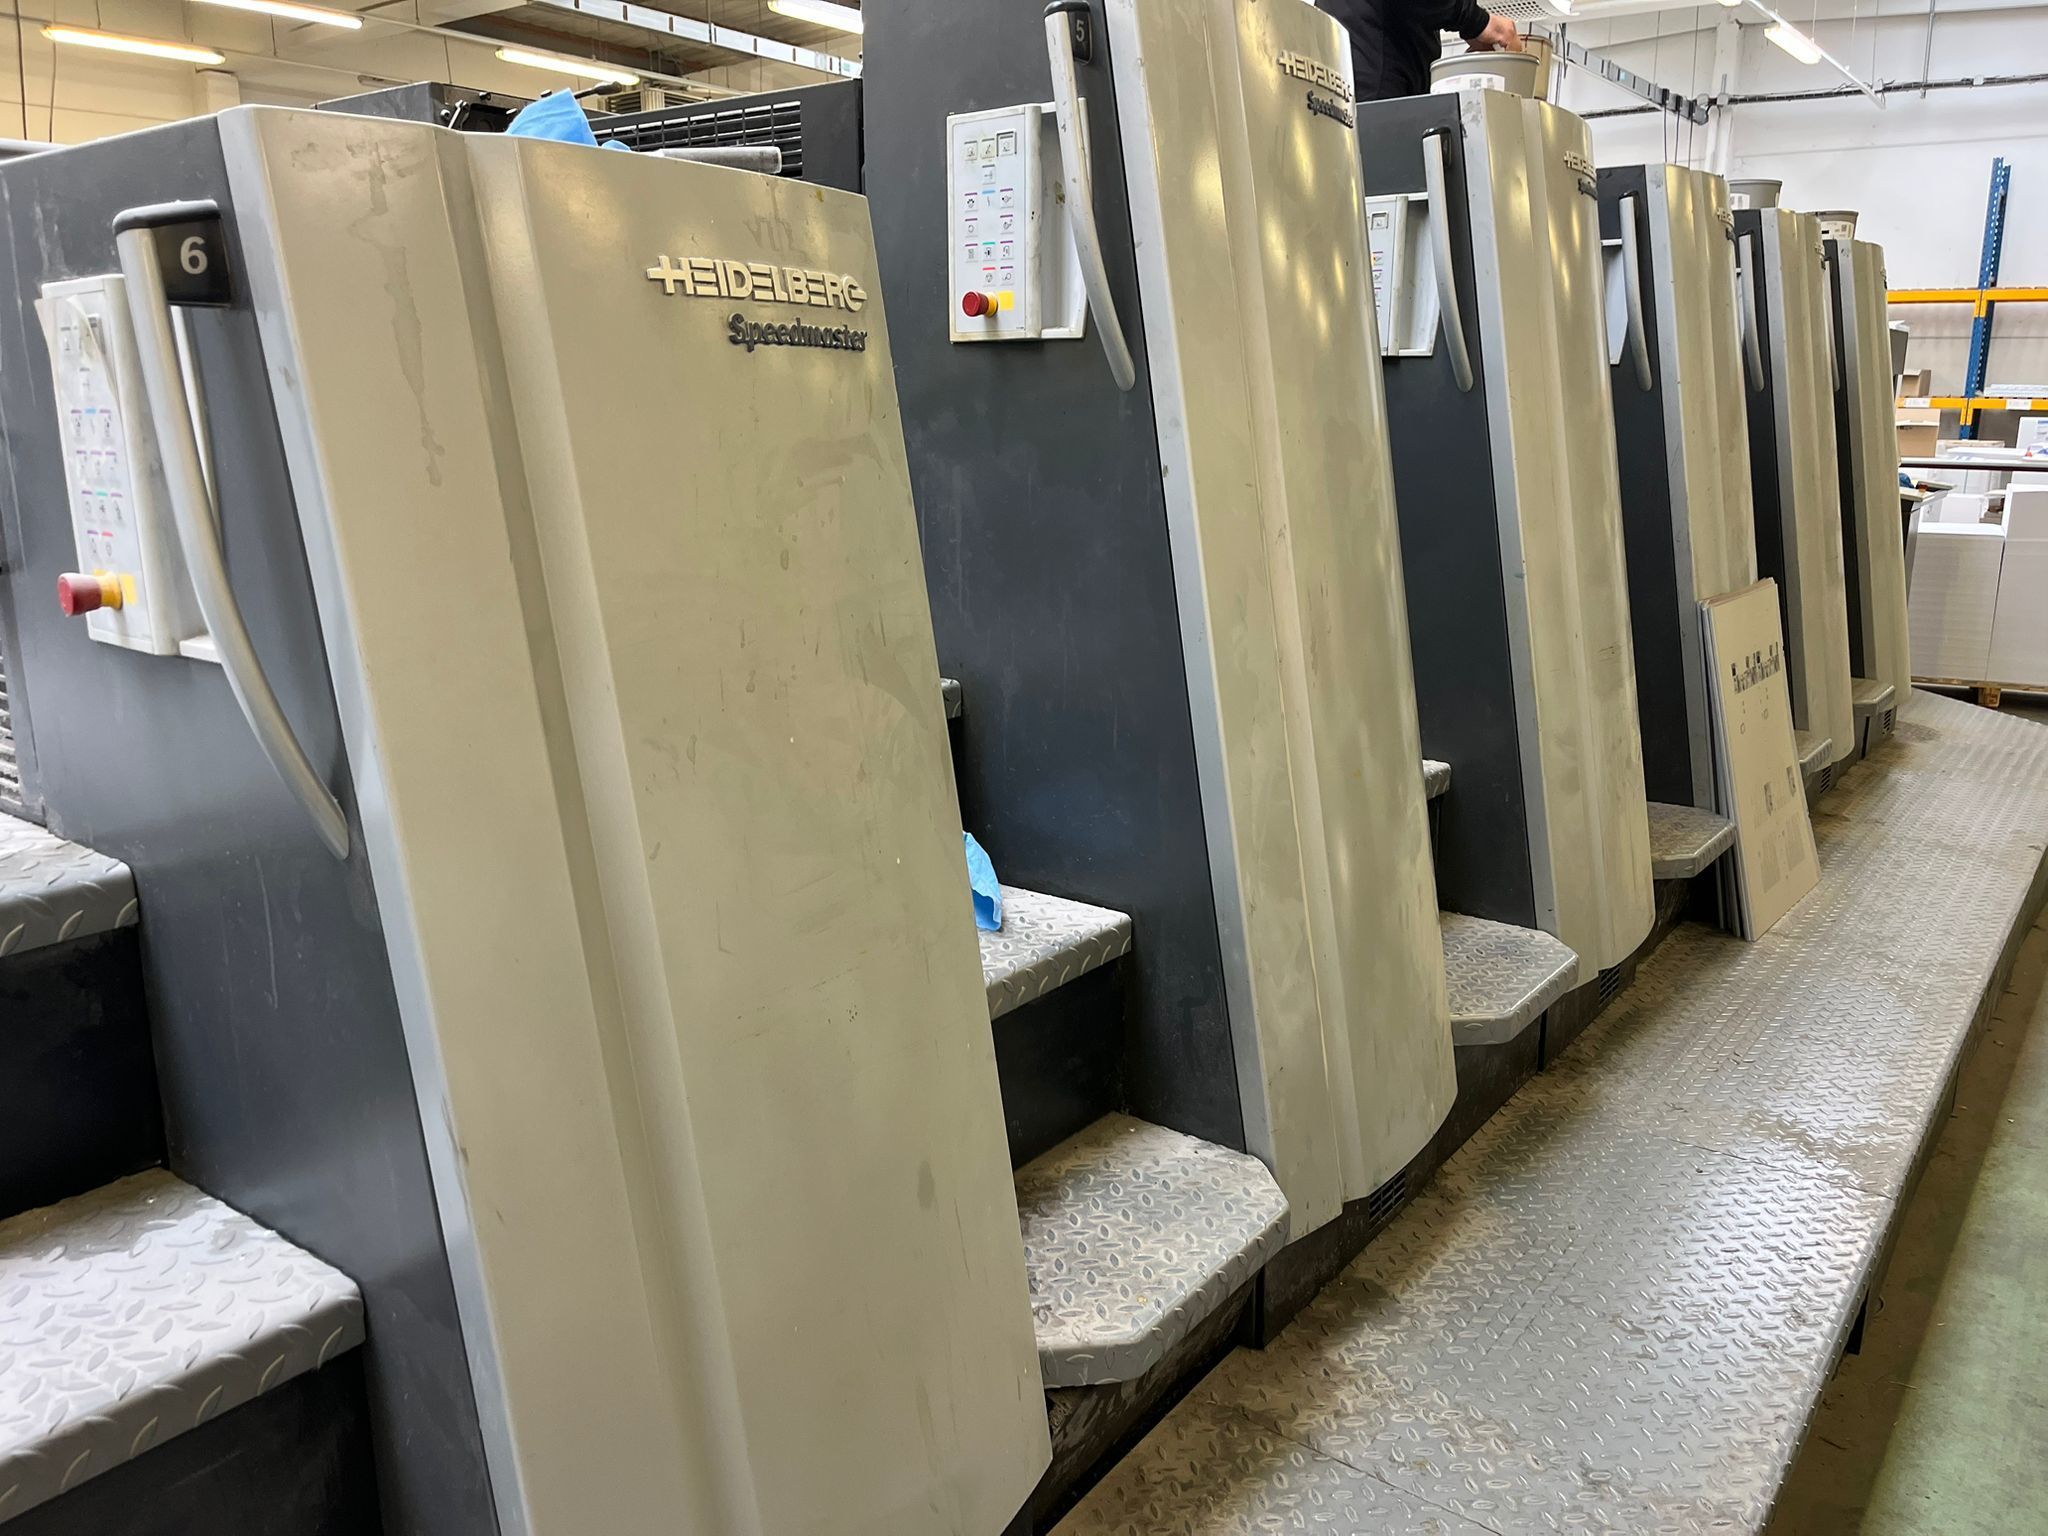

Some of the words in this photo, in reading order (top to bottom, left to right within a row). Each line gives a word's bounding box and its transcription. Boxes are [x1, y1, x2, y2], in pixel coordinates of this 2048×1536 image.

[1076, 19, 1085, 42] 5
[180, 235, 208, 275] 6
[647, 255, 868, 312] HEIDELBERG
[728, 312, 868, 352] Speedmaster
